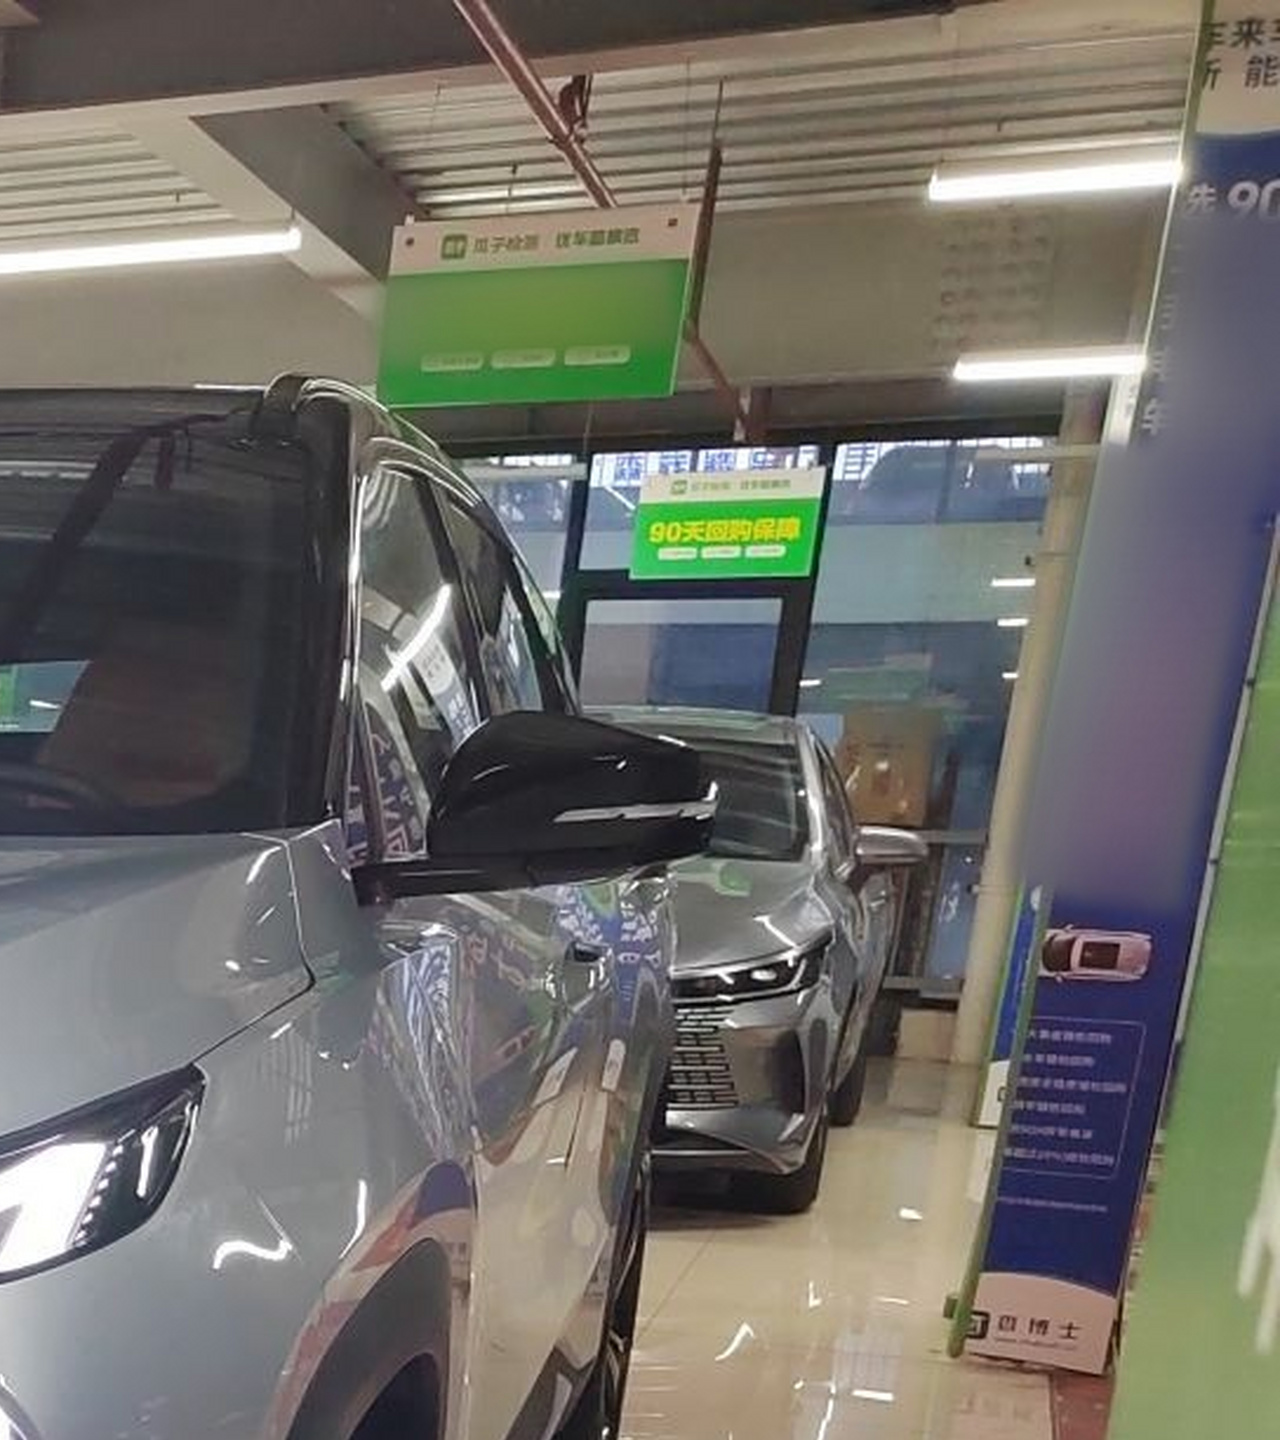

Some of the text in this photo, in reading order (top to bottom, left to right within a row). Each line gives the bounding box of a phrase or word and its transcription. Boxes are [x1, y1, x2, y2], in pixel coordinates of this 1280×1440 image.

[648, 517, 801, 543] 90天回购保障
